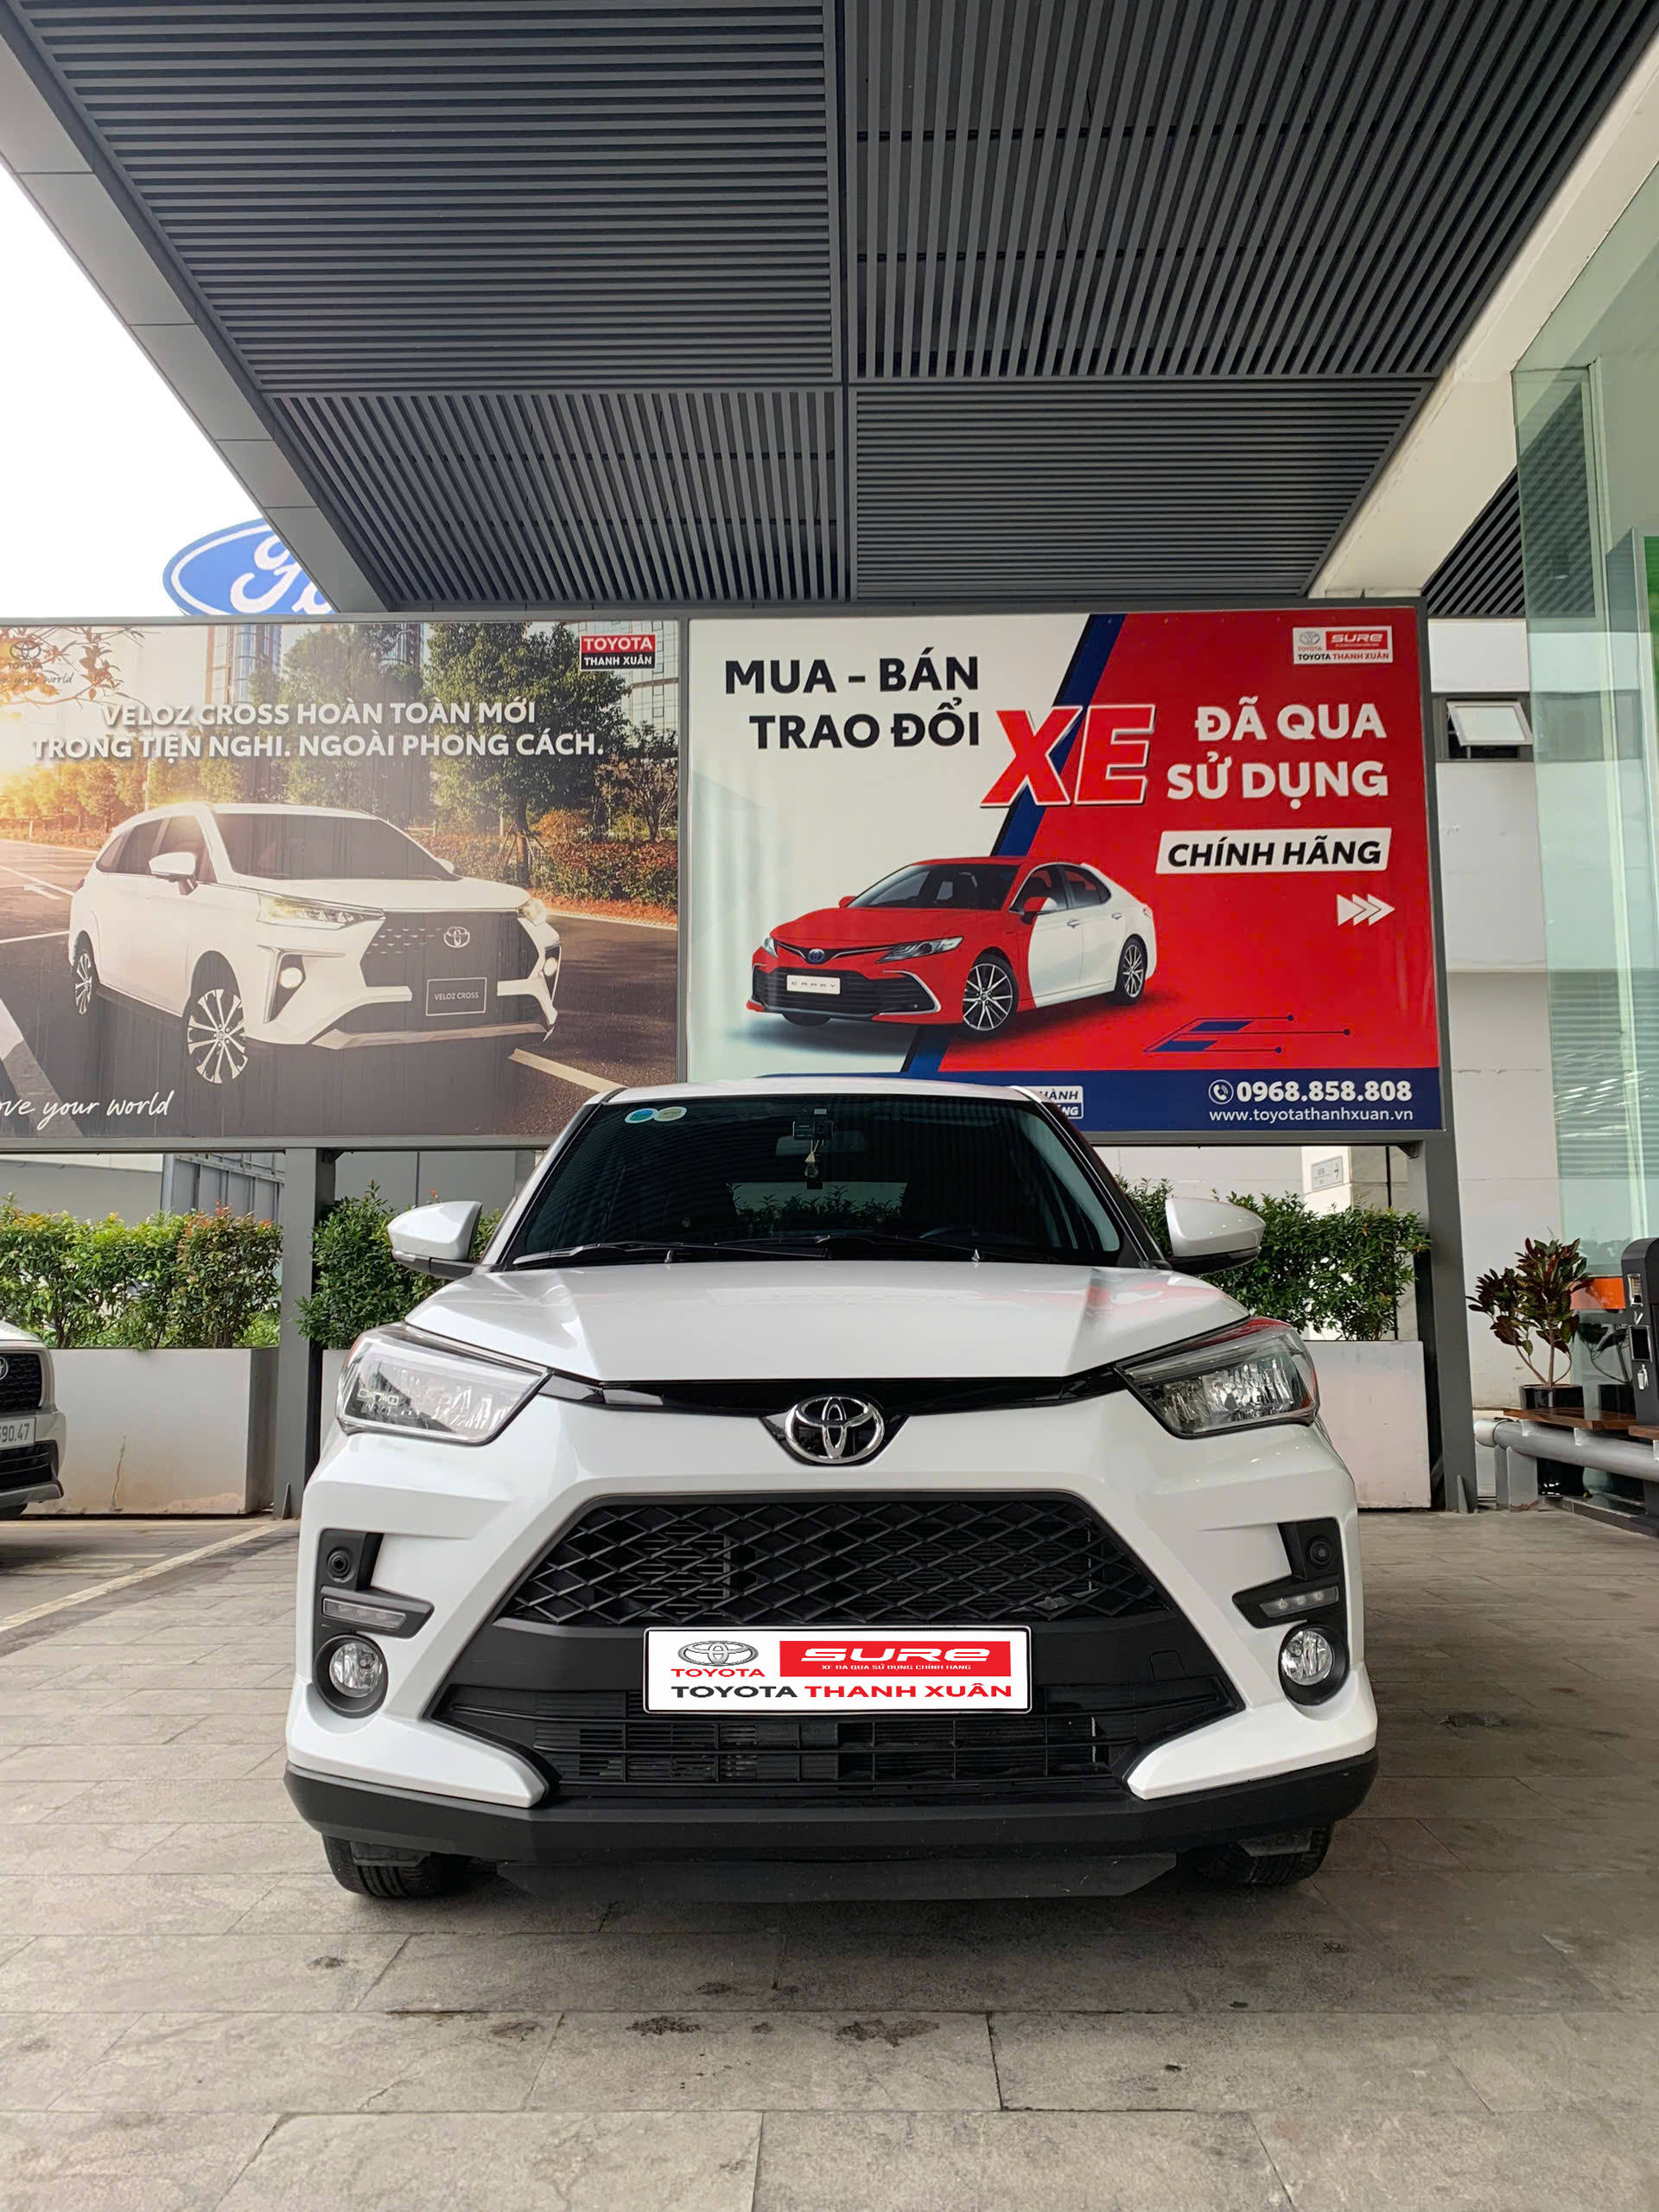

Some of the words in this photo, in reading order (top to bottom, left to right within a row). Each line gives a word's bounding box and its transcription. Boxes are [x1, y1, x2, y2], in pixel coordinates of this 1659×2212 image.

[584, 637, 653, 651] TOYOTA
[1298, 652, 1332, 661] TOYOTA
[1365, 651, 1389, 659] XUÂN
[584, 656, 620, 666] THANH
[623, 654, 652, 665] XUÂN
[725, 659, 836, 695] MUA
[880, 646, 978, 693] BÁN
[12, 677, 38, 690] your
[45, 672, 74, 683] world
[104, 704, 191, 726] VELOZ
[199, 703, 289, 725] CROSS
[297, 698, 383, 724] HOÀN
[390, 697, 470, 724] TOÀN
[479, 696, 535, 724] MỚI
[749, 713, 880, 750] TRAO
[890, 697, 979, 748] ĐỔI
[1194, 696, 1268, 742] ĐÃ
[1277, 703, 1387, 741] QUA
[33, 738, 132, 759] TRONG
[138, 734, 201, 764] TIỆN
[209, 735, 291, 758] NGHI.
[299, 730, 395, 757] NGOÀI
[403, 734, 510, 757] PHONG
[516, 728, 605, 756] CÁCH.
[979, 704, 1157, 809] XE
[1167, 751, 1233, 801] SỬ
[1242, 760, 1389, 810] DỤNG
[1167, 837, 1274, 867] CHÍNH
[1282, 836, 1382, 866] HÃNG
[456, 991, 480, 1000] CROSS
[1236, 1080, 1413, 1103] 0968.858.808
[37, 1101, 99, 1130] your
[106, 1090, 175, 1116] world
[1209, 1107, 1414, 1124] www.toyotathanhxuan.vn
[0, 1423, 30, 1443] 90.47
